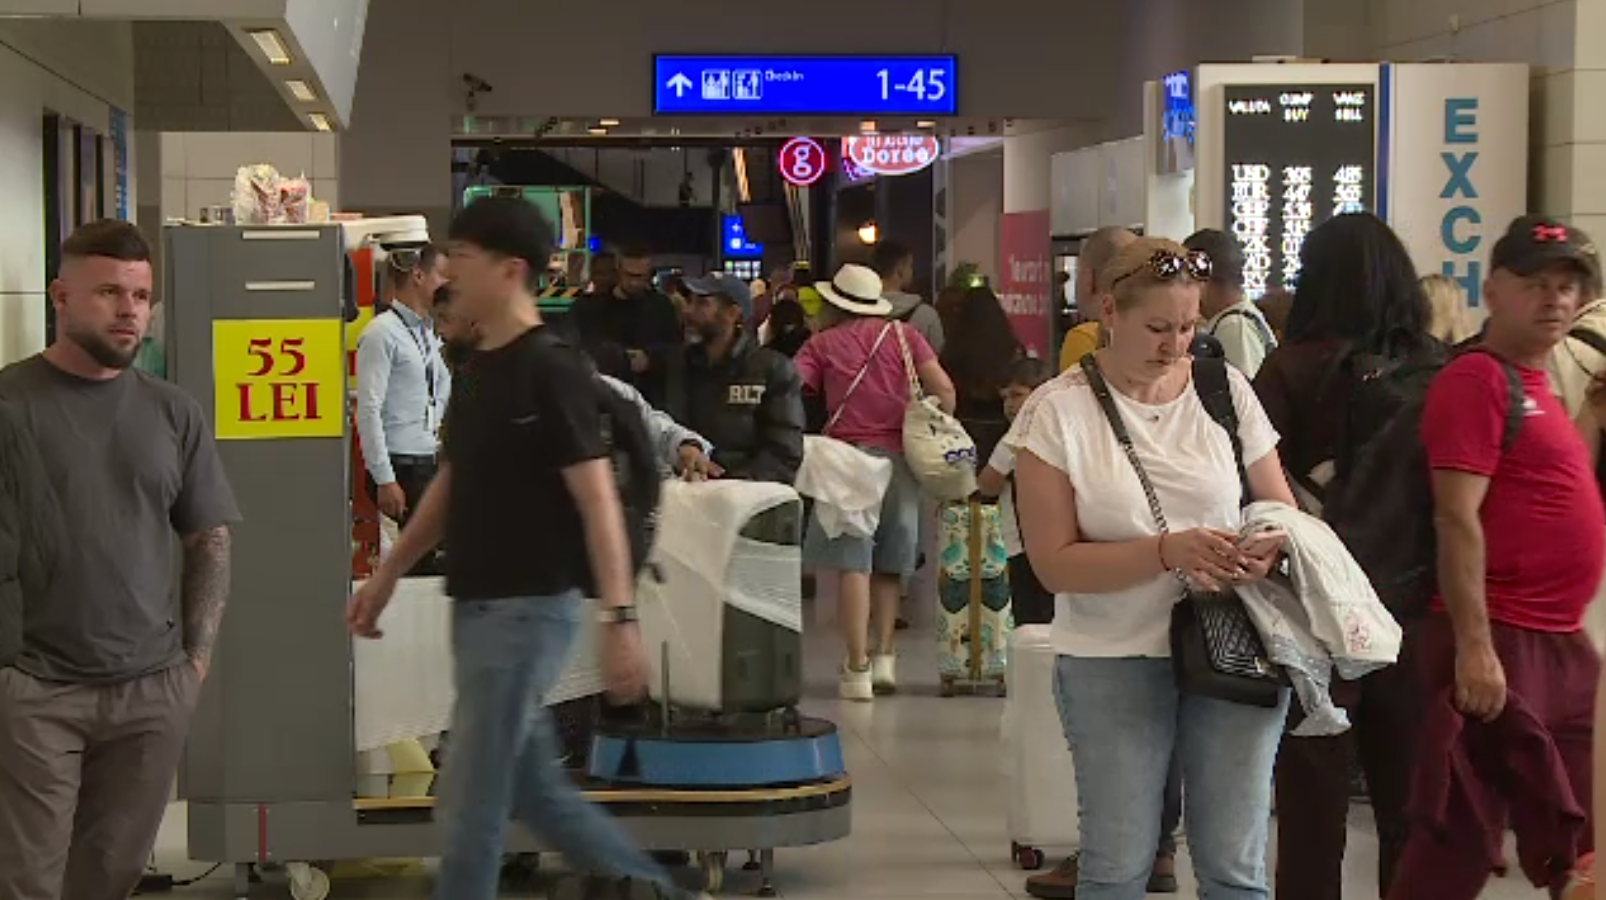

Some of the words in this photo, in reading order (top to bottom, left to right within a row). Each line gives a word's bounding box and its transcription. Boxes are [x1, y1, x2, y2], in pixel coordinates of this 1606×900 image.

[876, 69, 945, 100] 1-45
[1285, 108, 1309, 121] BUY
[1335, 108, 1362, 121] SELL
[793, 146, 812, 177] g
[1232, 164, 1270, 182] USD
[1232, 182, 1270, 200] EUR
[247, 337, 306, 376] 55
[235, 382, 322, 421] LEI
